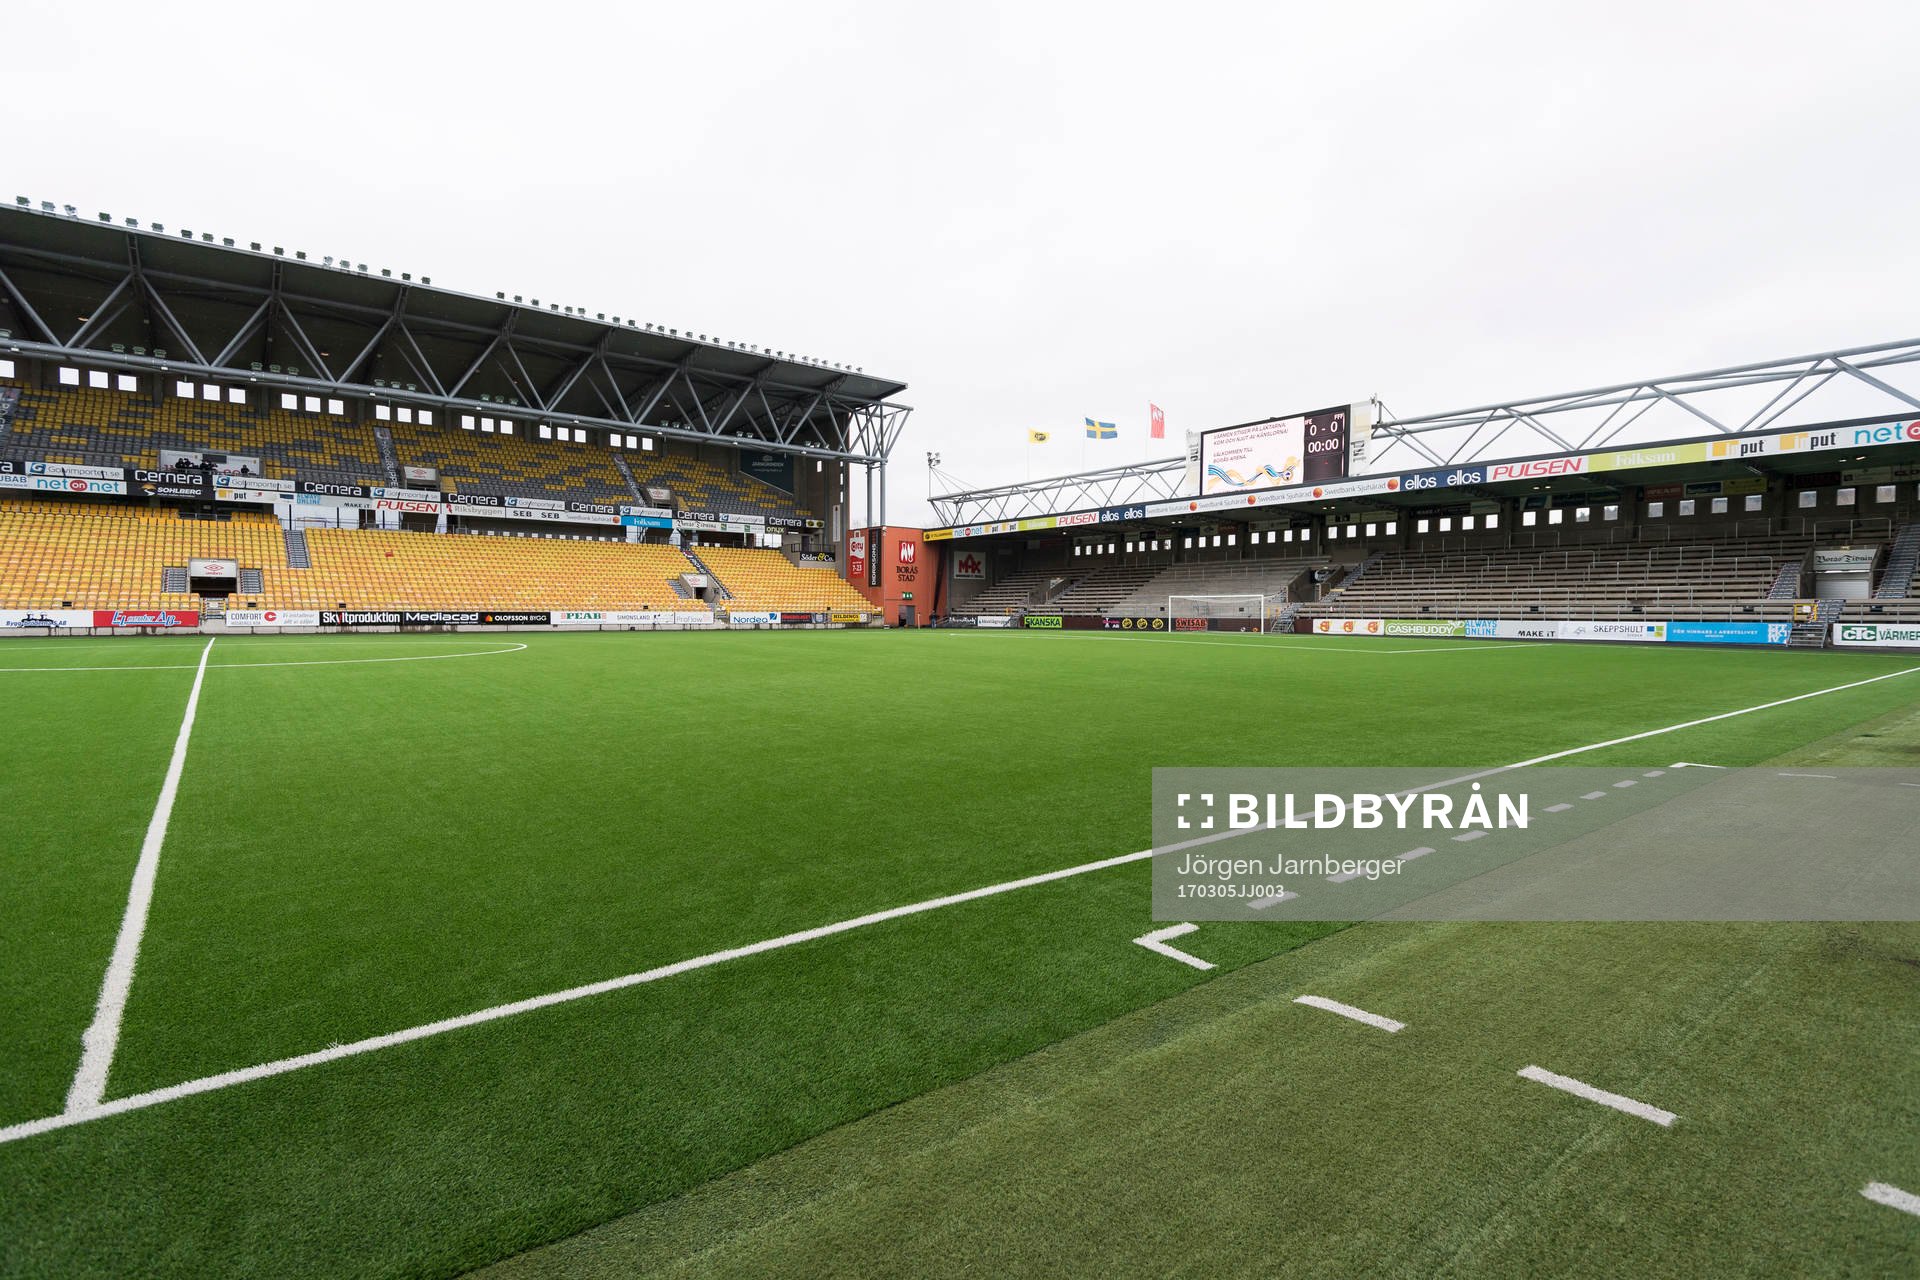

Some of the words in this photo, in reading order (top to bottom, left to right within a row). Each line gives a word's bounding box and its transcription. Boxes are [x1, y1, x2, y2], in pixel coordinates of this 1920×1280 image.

[1309, 424, 1317, 436] 0
[1330, 421, 1338, 433] 0
[1308, 438, 1339, 453] 00:00
[1492, 458, 1583, 480] PULSEN
[1405, 475, 1437, 490] ellos
[1447, 470, 1481, 486] ellos
[157, 486, 202, 496] SOHLBERG
[377, 500, 438, 512] PULSEN
[454, 505, 503, 515] Riksbyggen
[513, 510, 533, 518] SEB
[541, 511, 560, 519] SEB
[1058, 513, 1097, 526] PULSEN
[1101, 510, 1120, 522] ellos
[1124, 508, 1143, 519] ellos
[896, 565, 919, 575] BORÅS
[897, 574, 916, 582] STAD
[230, 613, 262, 621] COMFORT
[322, 612, 400, 625] Skyltproduktion
[405, 612, 479, 622] Mediacad
[566, 612, 602, 620] PEAB
[1025, 617, 1061, 627] SKANSKA
[1465, 620, 1497, 628] ALWAYS
[1387, 624, 1454, 635] CASHBUDDY
[1465, 627, 1497, 636] ONLINE
[1593, 625, 1644, 633] SKEPPSHULT
